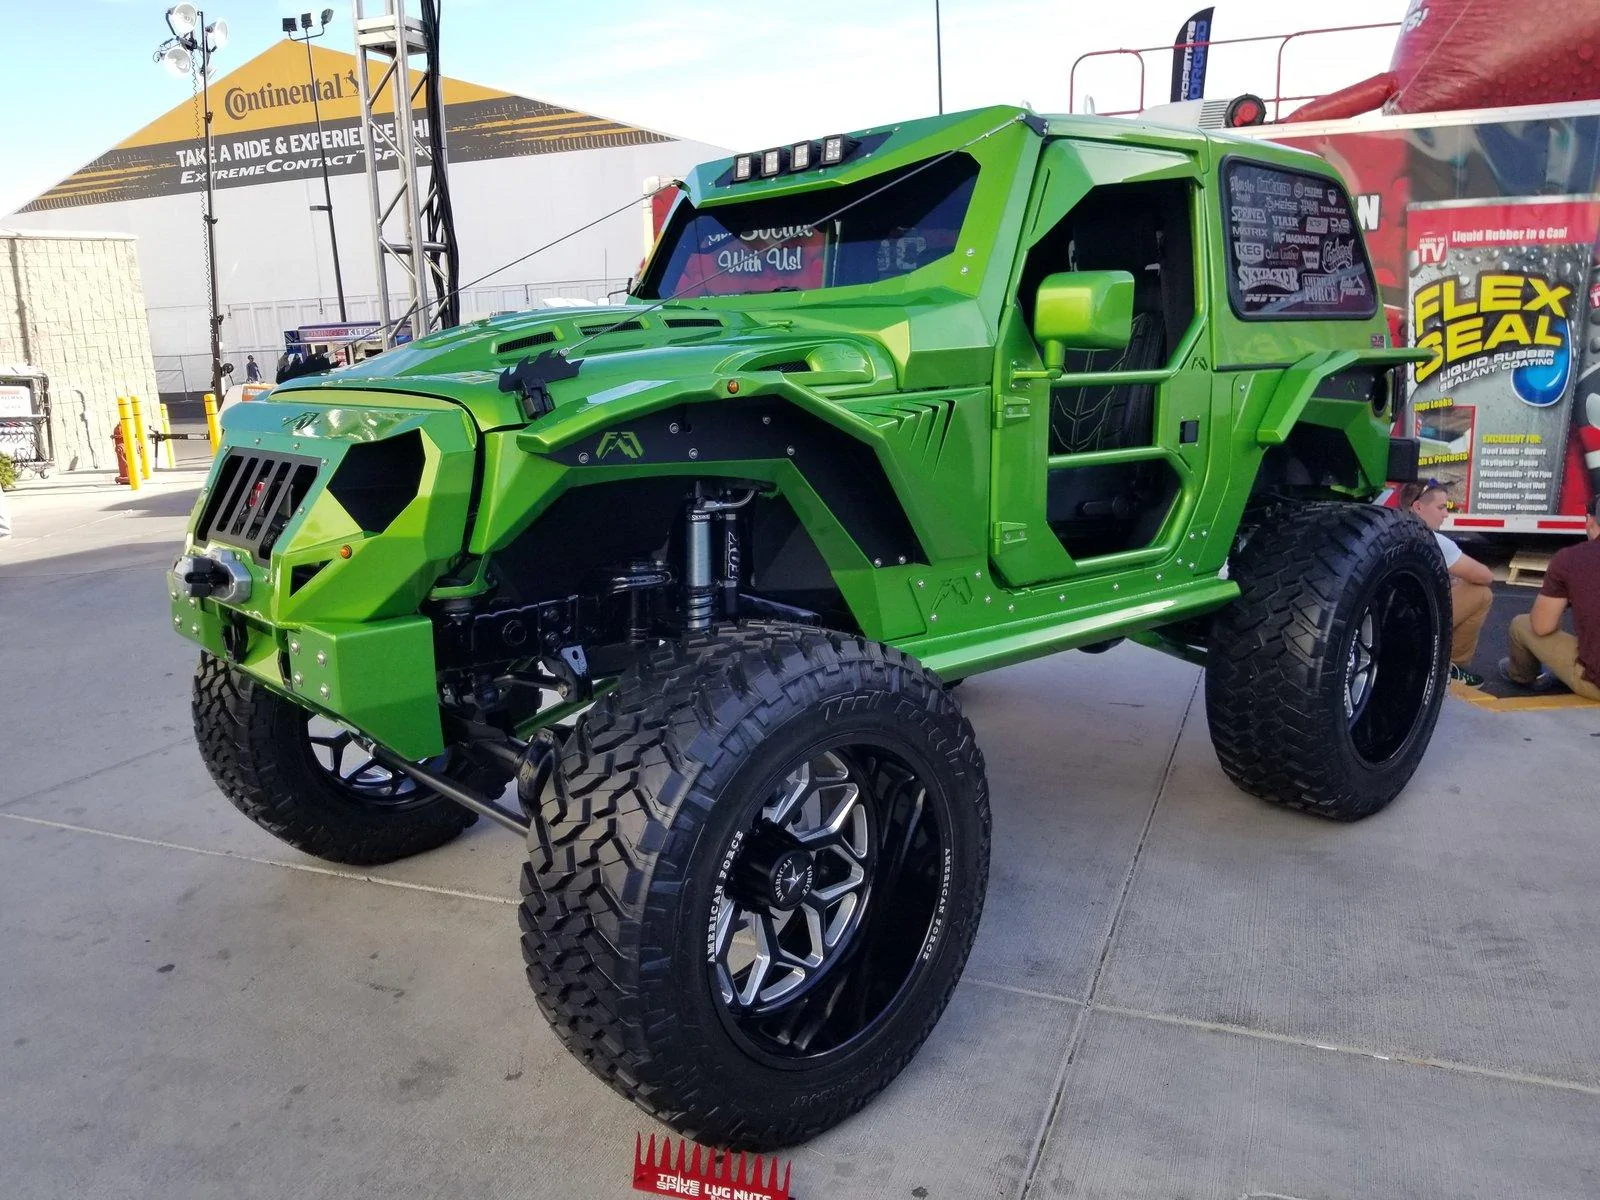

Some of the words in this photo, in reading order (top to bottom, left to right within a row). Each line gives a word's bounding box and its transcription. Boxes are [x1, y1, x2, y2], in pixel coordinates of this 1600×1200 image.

[1181, 20, 1196, 101] ROPSTARS
[1189, 20, 1208, 100] ORGED
[224, 73, 344, 121] Continental
[176, 147, 217, 168] TAKE
[220, 144, 235, 163] A
[235, 138, 273, 160] RIDE
[275, 136, 288, 155] &
[374, 144, 432, 161] SPRT
[1271, 215, 1299, 228] VIAIR
[1357, 194, 1380, 231] N
[1232, 226, 1268, 237] MATRIX
[1452, 230, 1485, 243] Liquid
[1485, 229, 1525, 241] Rubber
[718, 250, 762, 273] With
[766, 246, 802, 271] Us!
[1238, 245, 1261, 256] KEG
[1419, 242, 1445, 262] TV
[1238, 266, 1299, 292] SKYJACKER
[1304, 286, 1337, 302] FORCE
[1415, 275, 1571, 338] FLEX
[1415, 313, 1562, 383] SEAL
[1439, 356, 1488, 382] LIQUID
[1494, 350, 1555, 365] RUBBER
[1439, 366, 1497, 393] SEALANT
[1501, 358, 1555, 371] COATING
[1430, 397, 1453, 410] Leaks
[1434, 452, 1469, 464] Protects
[1477, 502, 1512, 511] Chimneys
[774, 857, 793, 902] AMERICAN
[802, 865, 813, 896] FORCE
[938, 848, 951, 914] AMERICAN
[707, 884, 724, 963] AMERICAN
[719, 830, 744, 879] FORCE
[922, 918, 942, 960] FORCE
[656, 1171, 700, 1197] SPIKE
[704, 1183, 731, 1199] LUG
[657, 1173, 700, 1187] TRUE
